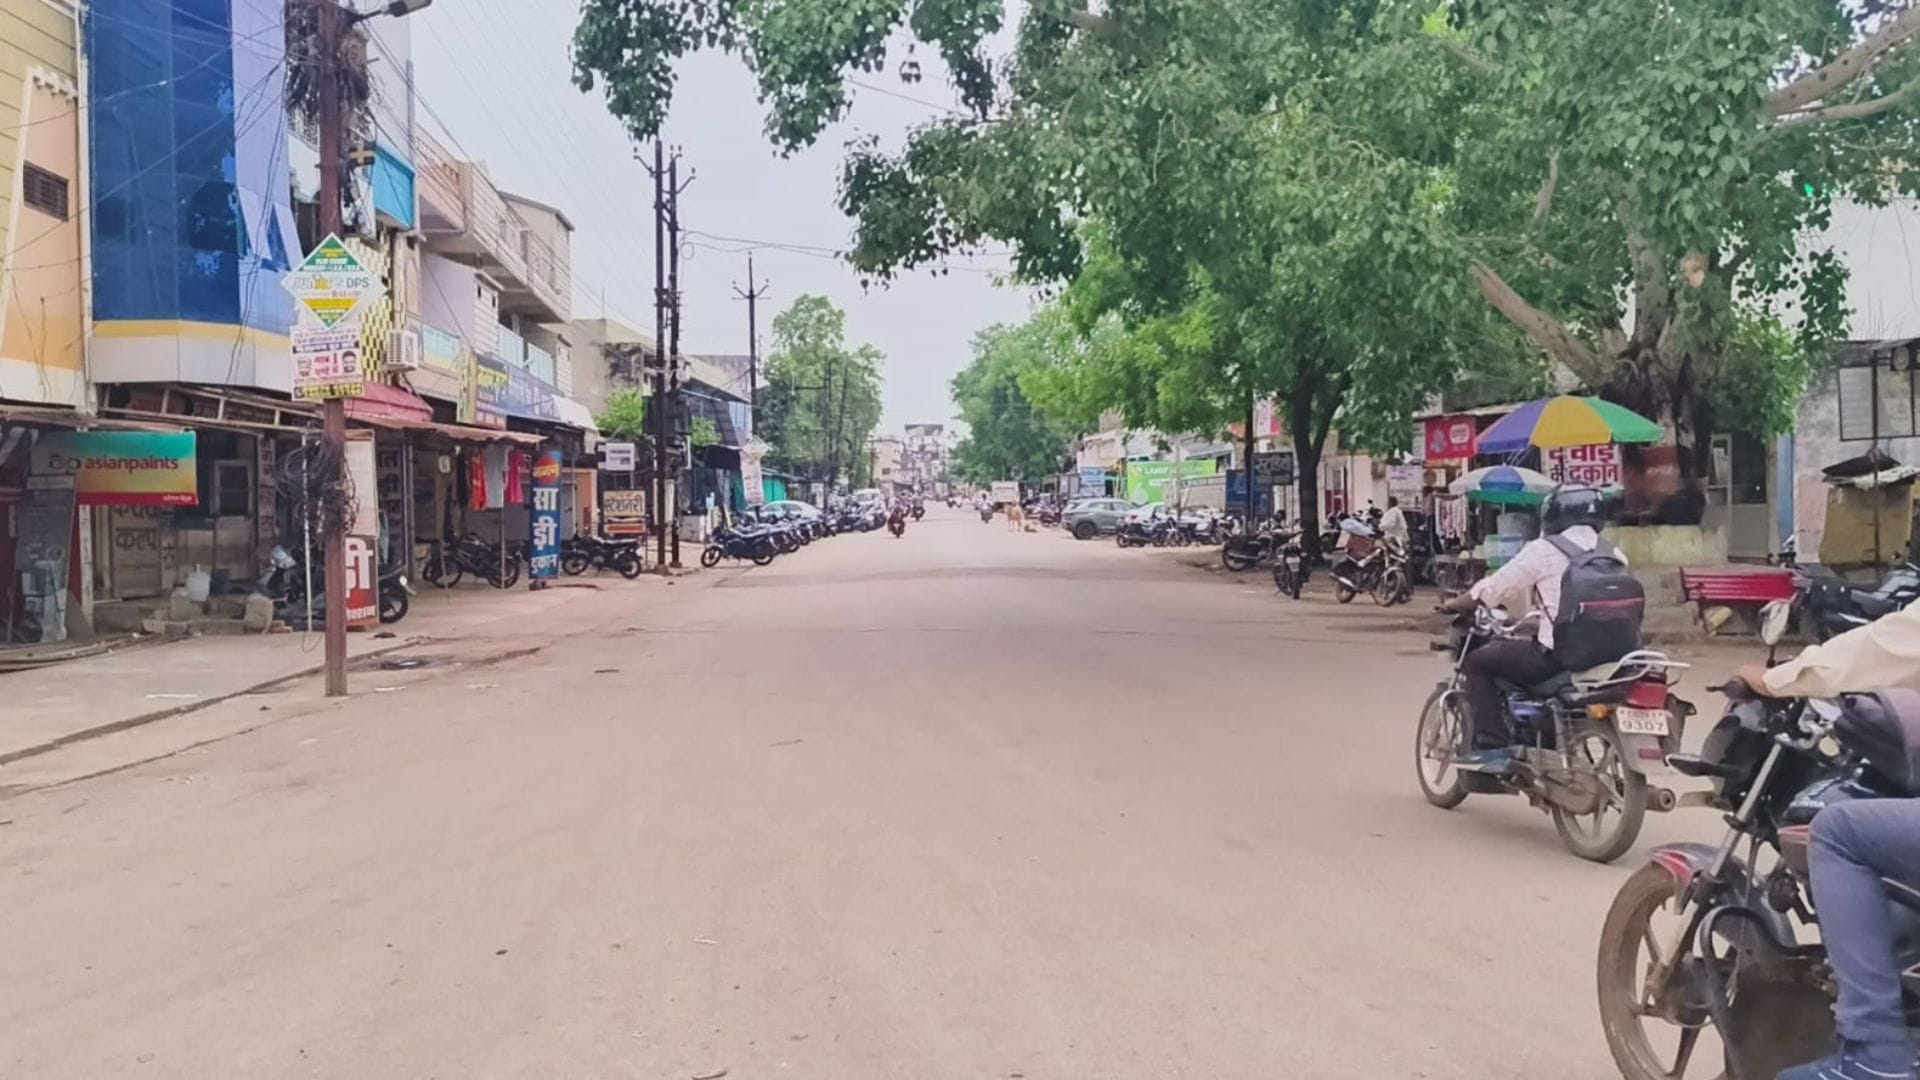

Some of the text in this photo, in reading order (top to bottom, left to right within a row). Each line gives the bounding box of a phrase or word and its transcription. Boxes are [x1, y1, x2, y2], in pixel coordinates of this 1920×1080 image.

[345, 277, 370, 289] DPS
[85, 454, 179, 474] asianpaints
[603, 493, 644, 514] स्टेशनरी
[529, 553, 559, 576] दुकान
[1621, 720, 1664, 732] 9307
